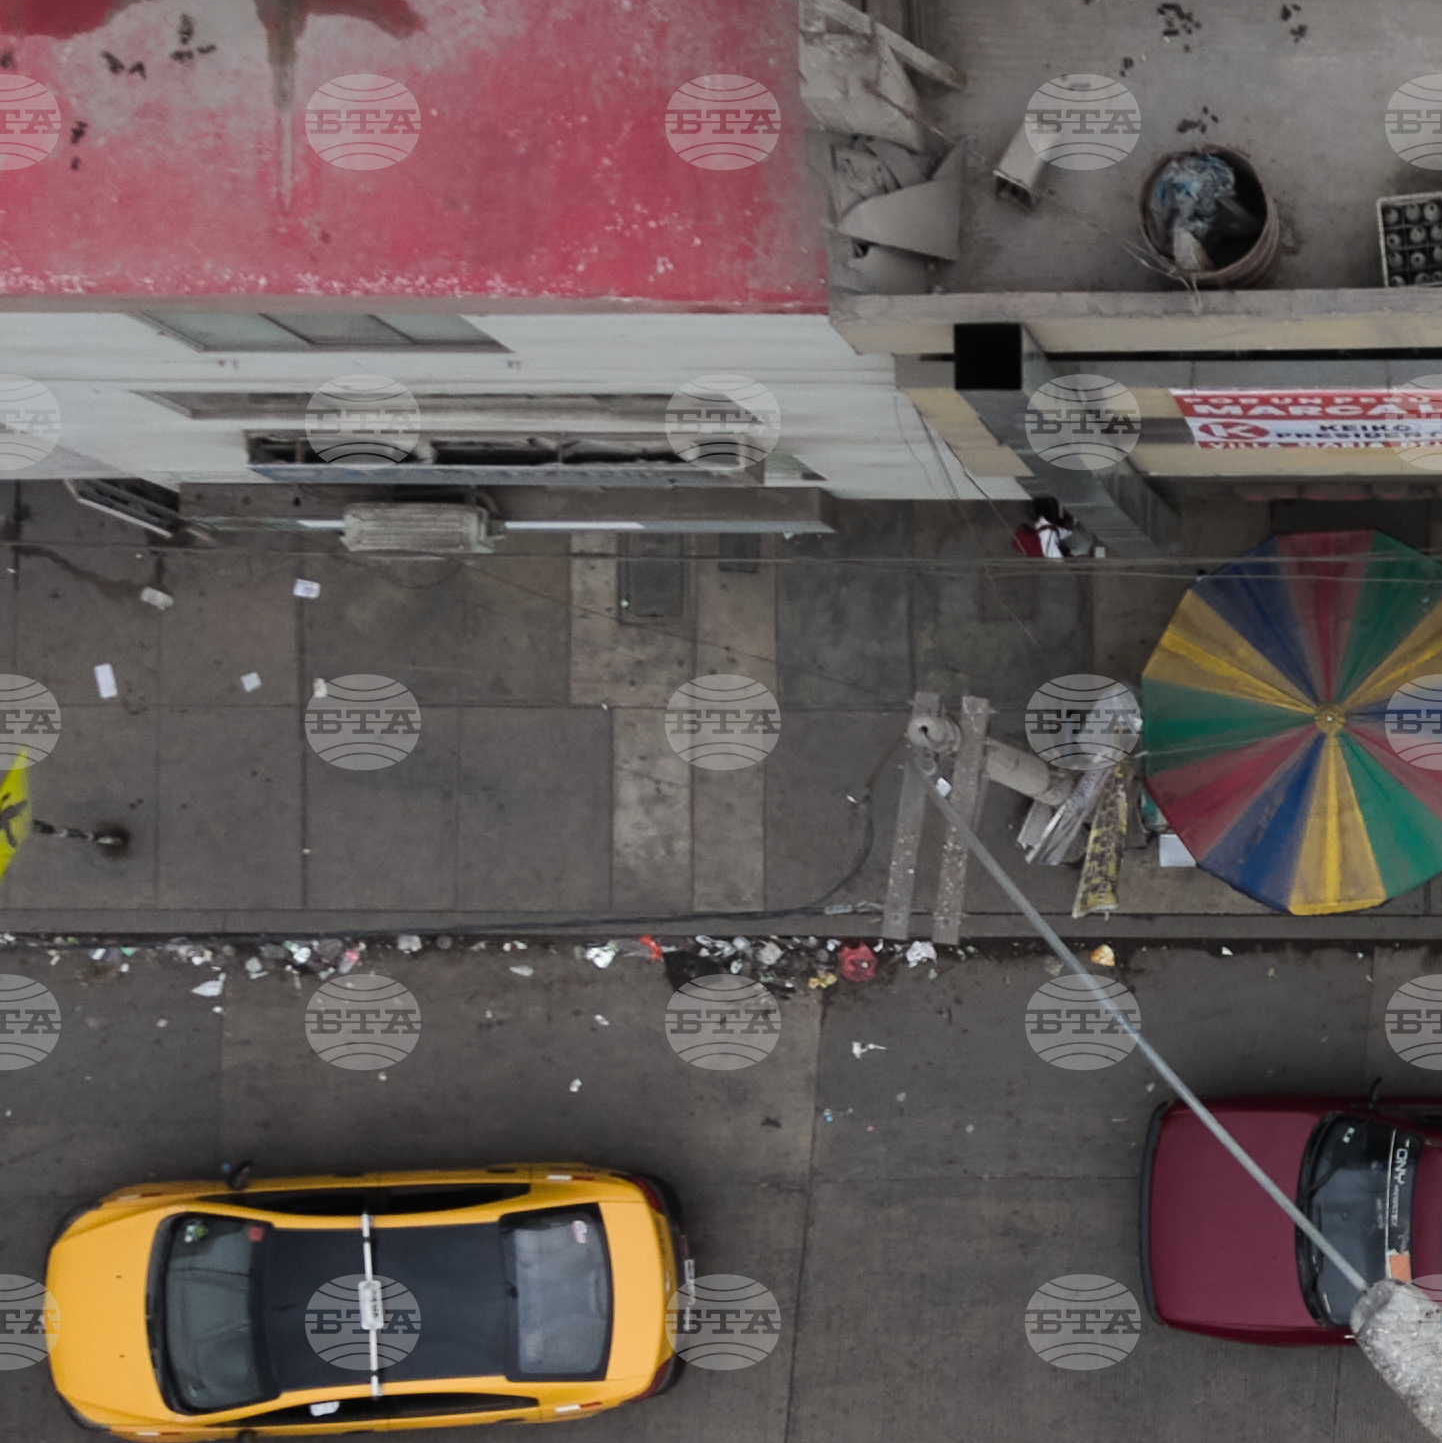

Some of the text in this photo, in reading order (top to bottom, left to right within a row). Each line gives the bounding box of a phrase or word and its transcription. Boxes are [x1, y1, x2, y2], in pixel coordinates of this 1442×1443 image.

[1192, 403, 1408, 416] MARCA
[1208, 422, 1257, 439] K
[1319, 424, 1413, 432] KEIKO
